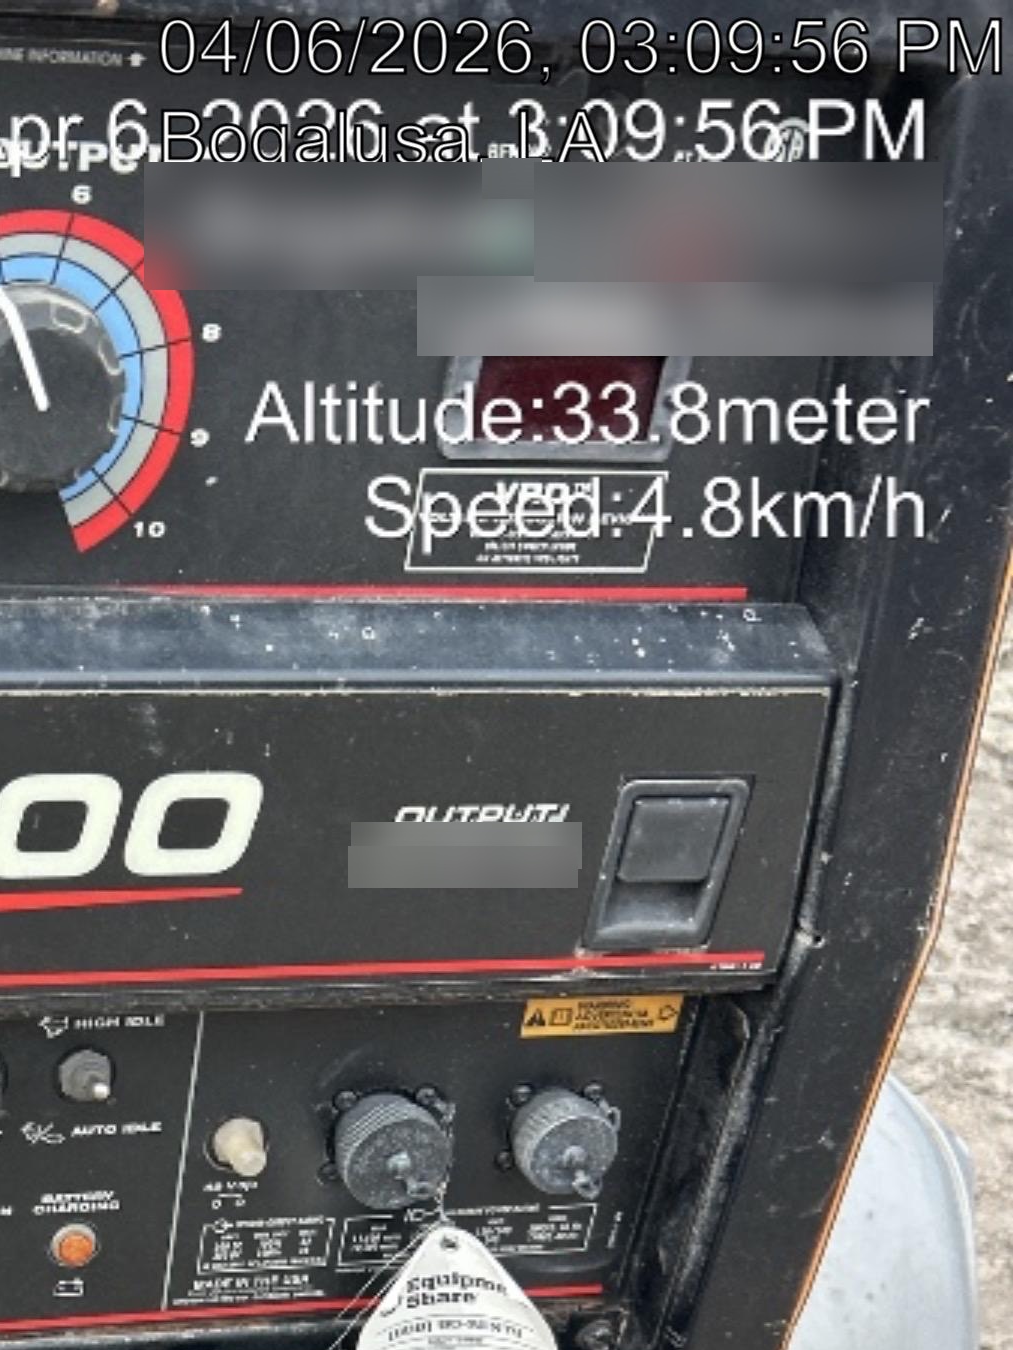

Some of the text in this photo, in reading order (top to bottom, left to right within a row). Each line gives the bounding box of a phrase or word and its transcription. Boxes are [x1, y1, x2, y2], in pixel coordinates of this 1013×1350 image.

[28, 46, 123, 67] INFORMATION
[71, 184, 93, 204] 6
[201, 322, 223, 343] 8
[190, 427, 211, 447] 9
[133, 520, 167, 538] 10
[73, 1014, 166, 1030] HIGH IDLE
[70, 1123, 118, 1138] AUTO
